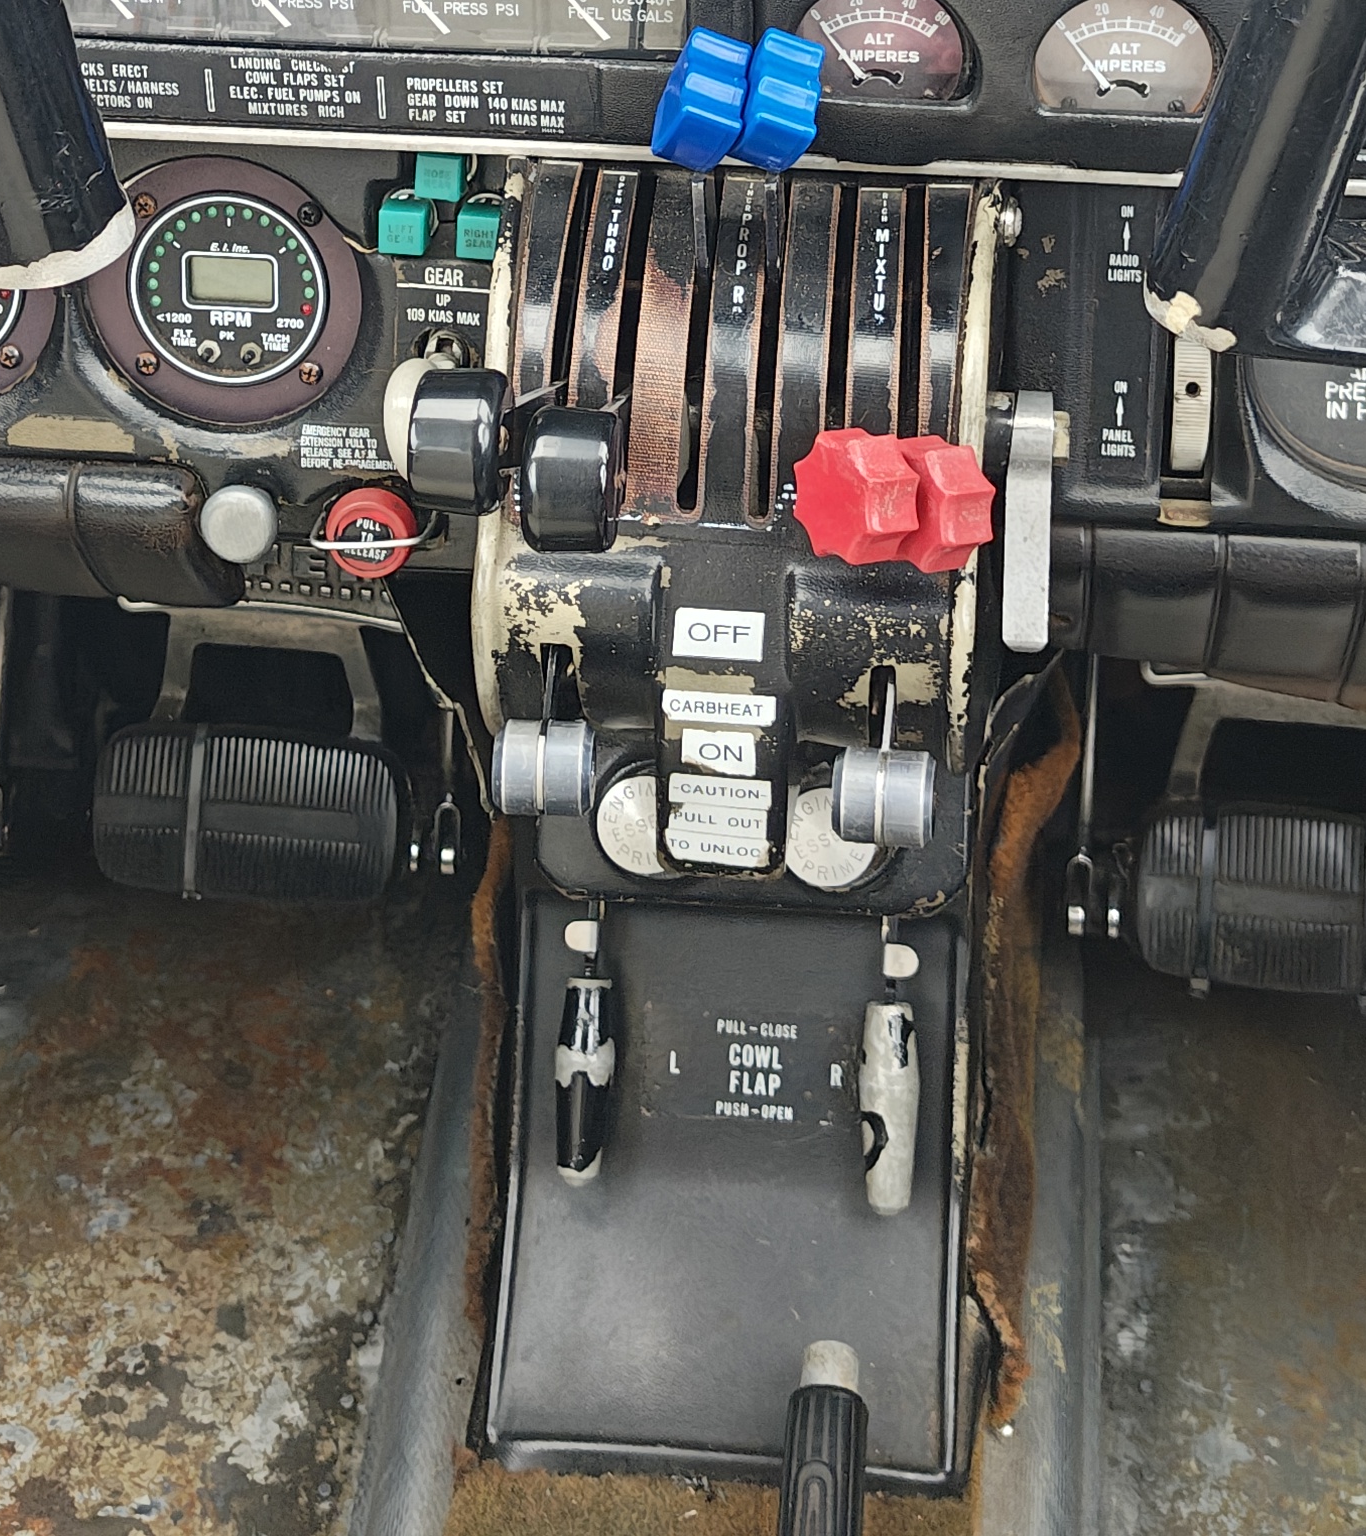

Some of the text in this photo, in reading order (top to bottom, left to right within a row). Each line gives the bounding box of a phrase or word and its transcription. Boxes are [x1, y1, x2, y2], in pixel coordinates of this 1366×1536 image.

[443, 1, 519, 17] PRESS PSI
[863, 32, 895, 46] ALT
[1109, 42, 1141, 56] ALT
[406, 77, 504, 95] PROPELLERS SET
[1109, 253, 1139, 268] RADIO
[424, 266, 464, 287] GEAR
[1107, 268, 1143, 283] LIGHTS
[435, 293, 451, 307] UP
[209, 310, 252, 328] RPM
[276, 317, 305, 330] 2700
[1326, 400, 1348, 420] IN
[687, 622, 751, 644] OFF
[669, 698, 763, 717] CARBHEAT
[698, 743, 743, 762] ON
[728, 1042, 783, 1070] COWL
[729, 1070, 781, 1097] FLAP
